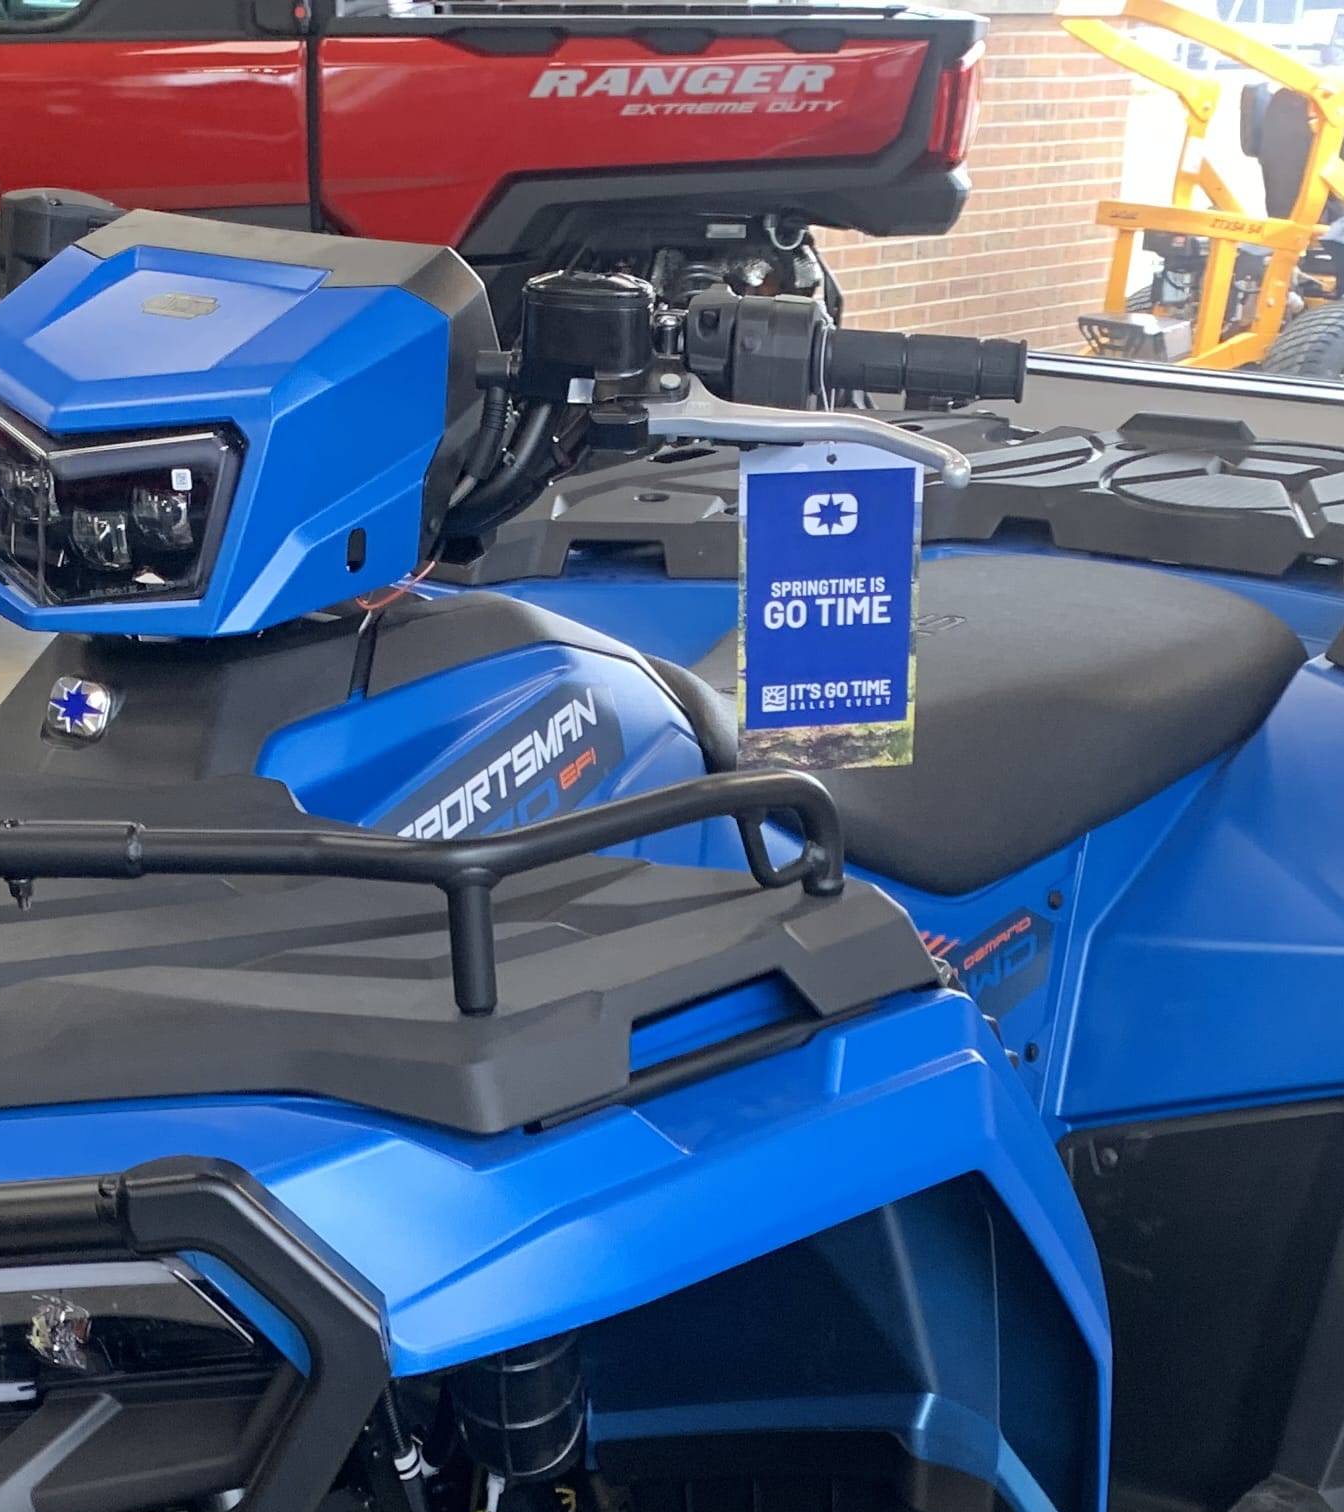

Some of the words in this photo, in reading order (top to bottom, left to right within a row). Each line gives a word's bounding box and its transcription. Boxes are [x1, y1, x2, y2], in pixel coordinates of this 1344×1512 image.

[529, 64, 835, 98] RANGER
[620, 101, 760, 116] EXTREME
[765, 99, 843, 113] DUTY
[770, 578, 866, 599] SPRINGTIME
[870, 576, 886, 593] IS
[763, 600, 807, 630] GO
[814, 595, 892, 627] TIME
[790, 683, 821, 701] IT'S
[824, 681, 848, 699] GO
[851, 679, 891, 698] TIME
[560, 747, 597, 791] EFI
